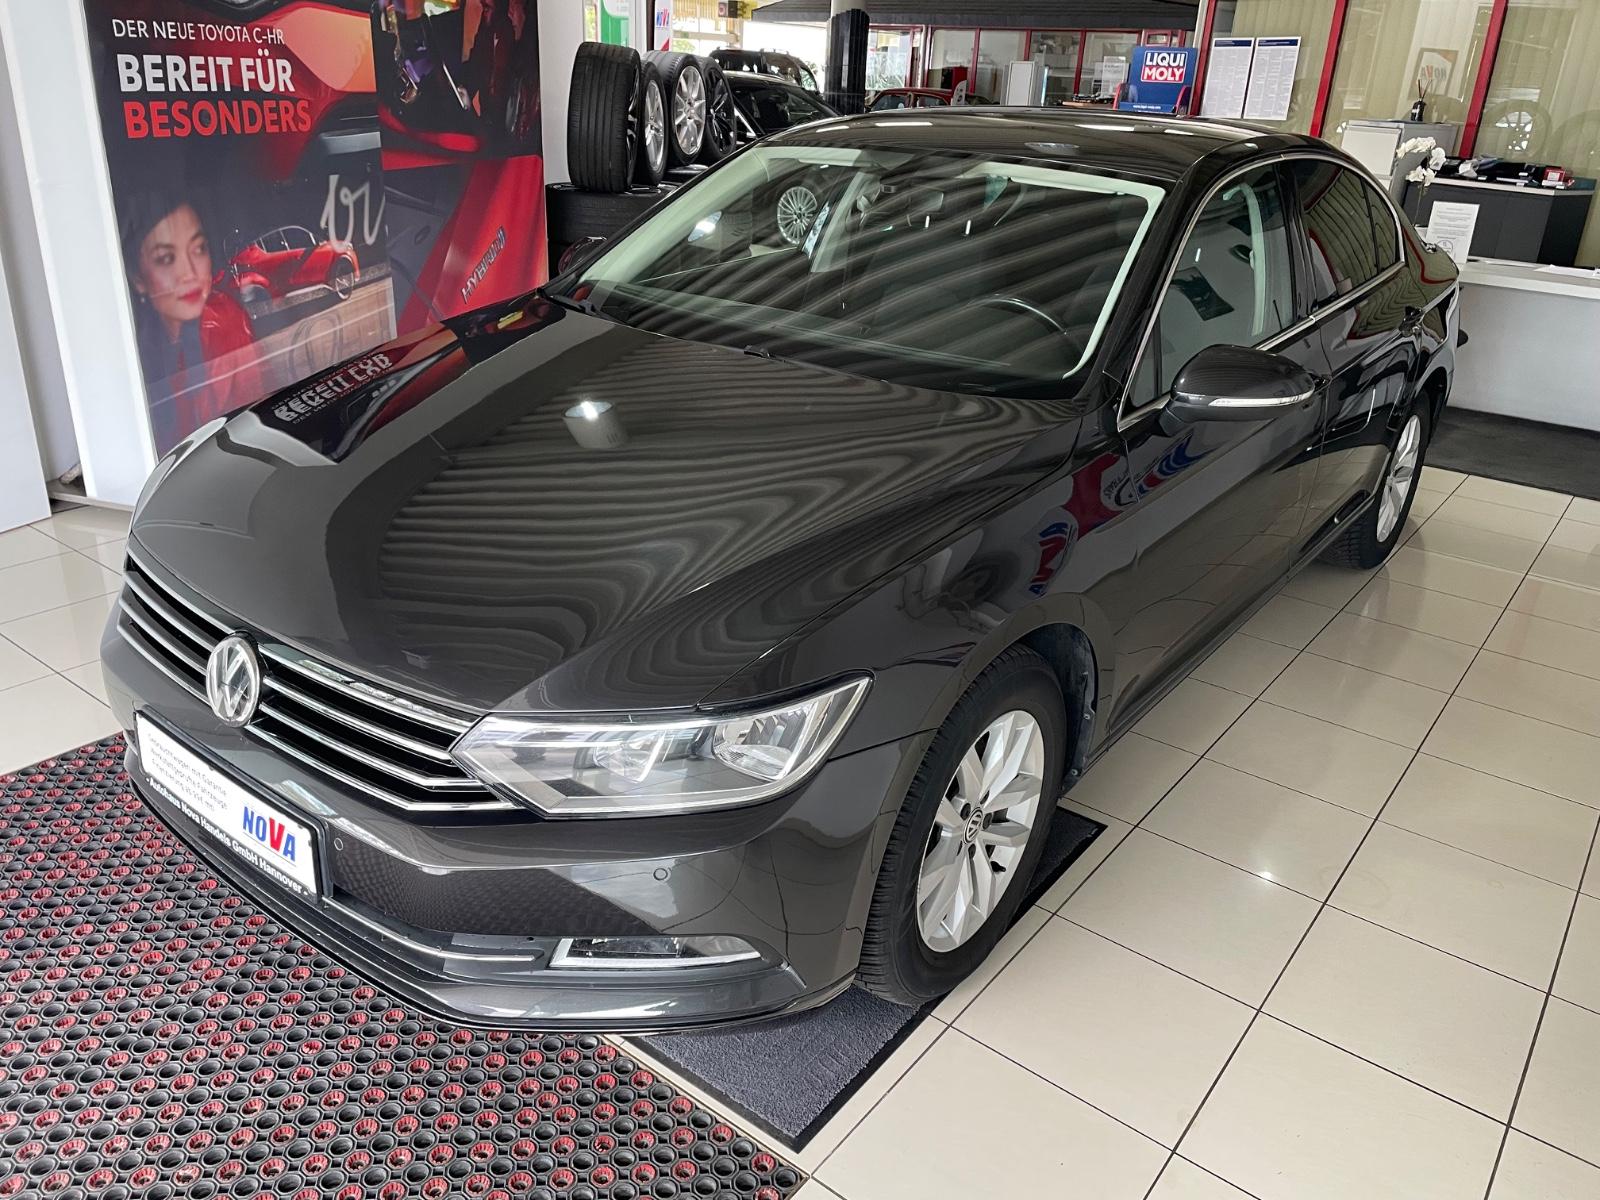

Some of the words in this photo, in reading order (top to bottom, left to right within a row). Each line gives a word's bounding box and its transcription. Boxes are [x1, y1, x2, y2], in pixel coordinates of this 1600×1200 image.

[112, 19, 149, 38] DER
[153, 20, 196, 40] NEUE
[198, 23, 251, 43] TOYOTA
[253, 27, 286, 44] C-HR
[117, 53, 233, 93] BEREIT
[240, 48, 296, 92] FÜR
[1143, 67, 1184, 81] MOLY
[1146, 52, 1186, 67] LIQUI
[123, 99, 312, 139] BESONDERS
[461, 224, 506, 304] HYBRID
[149, 776, 181, 810] Autohaus
[181, 801, 201, 825] Nova
[200, 816, 232, 848] Handels
[231, 839, 259, 867] GmbH
[259, 857, 302, 893] Hannover
[242, 805, 297, 862] NOVA
